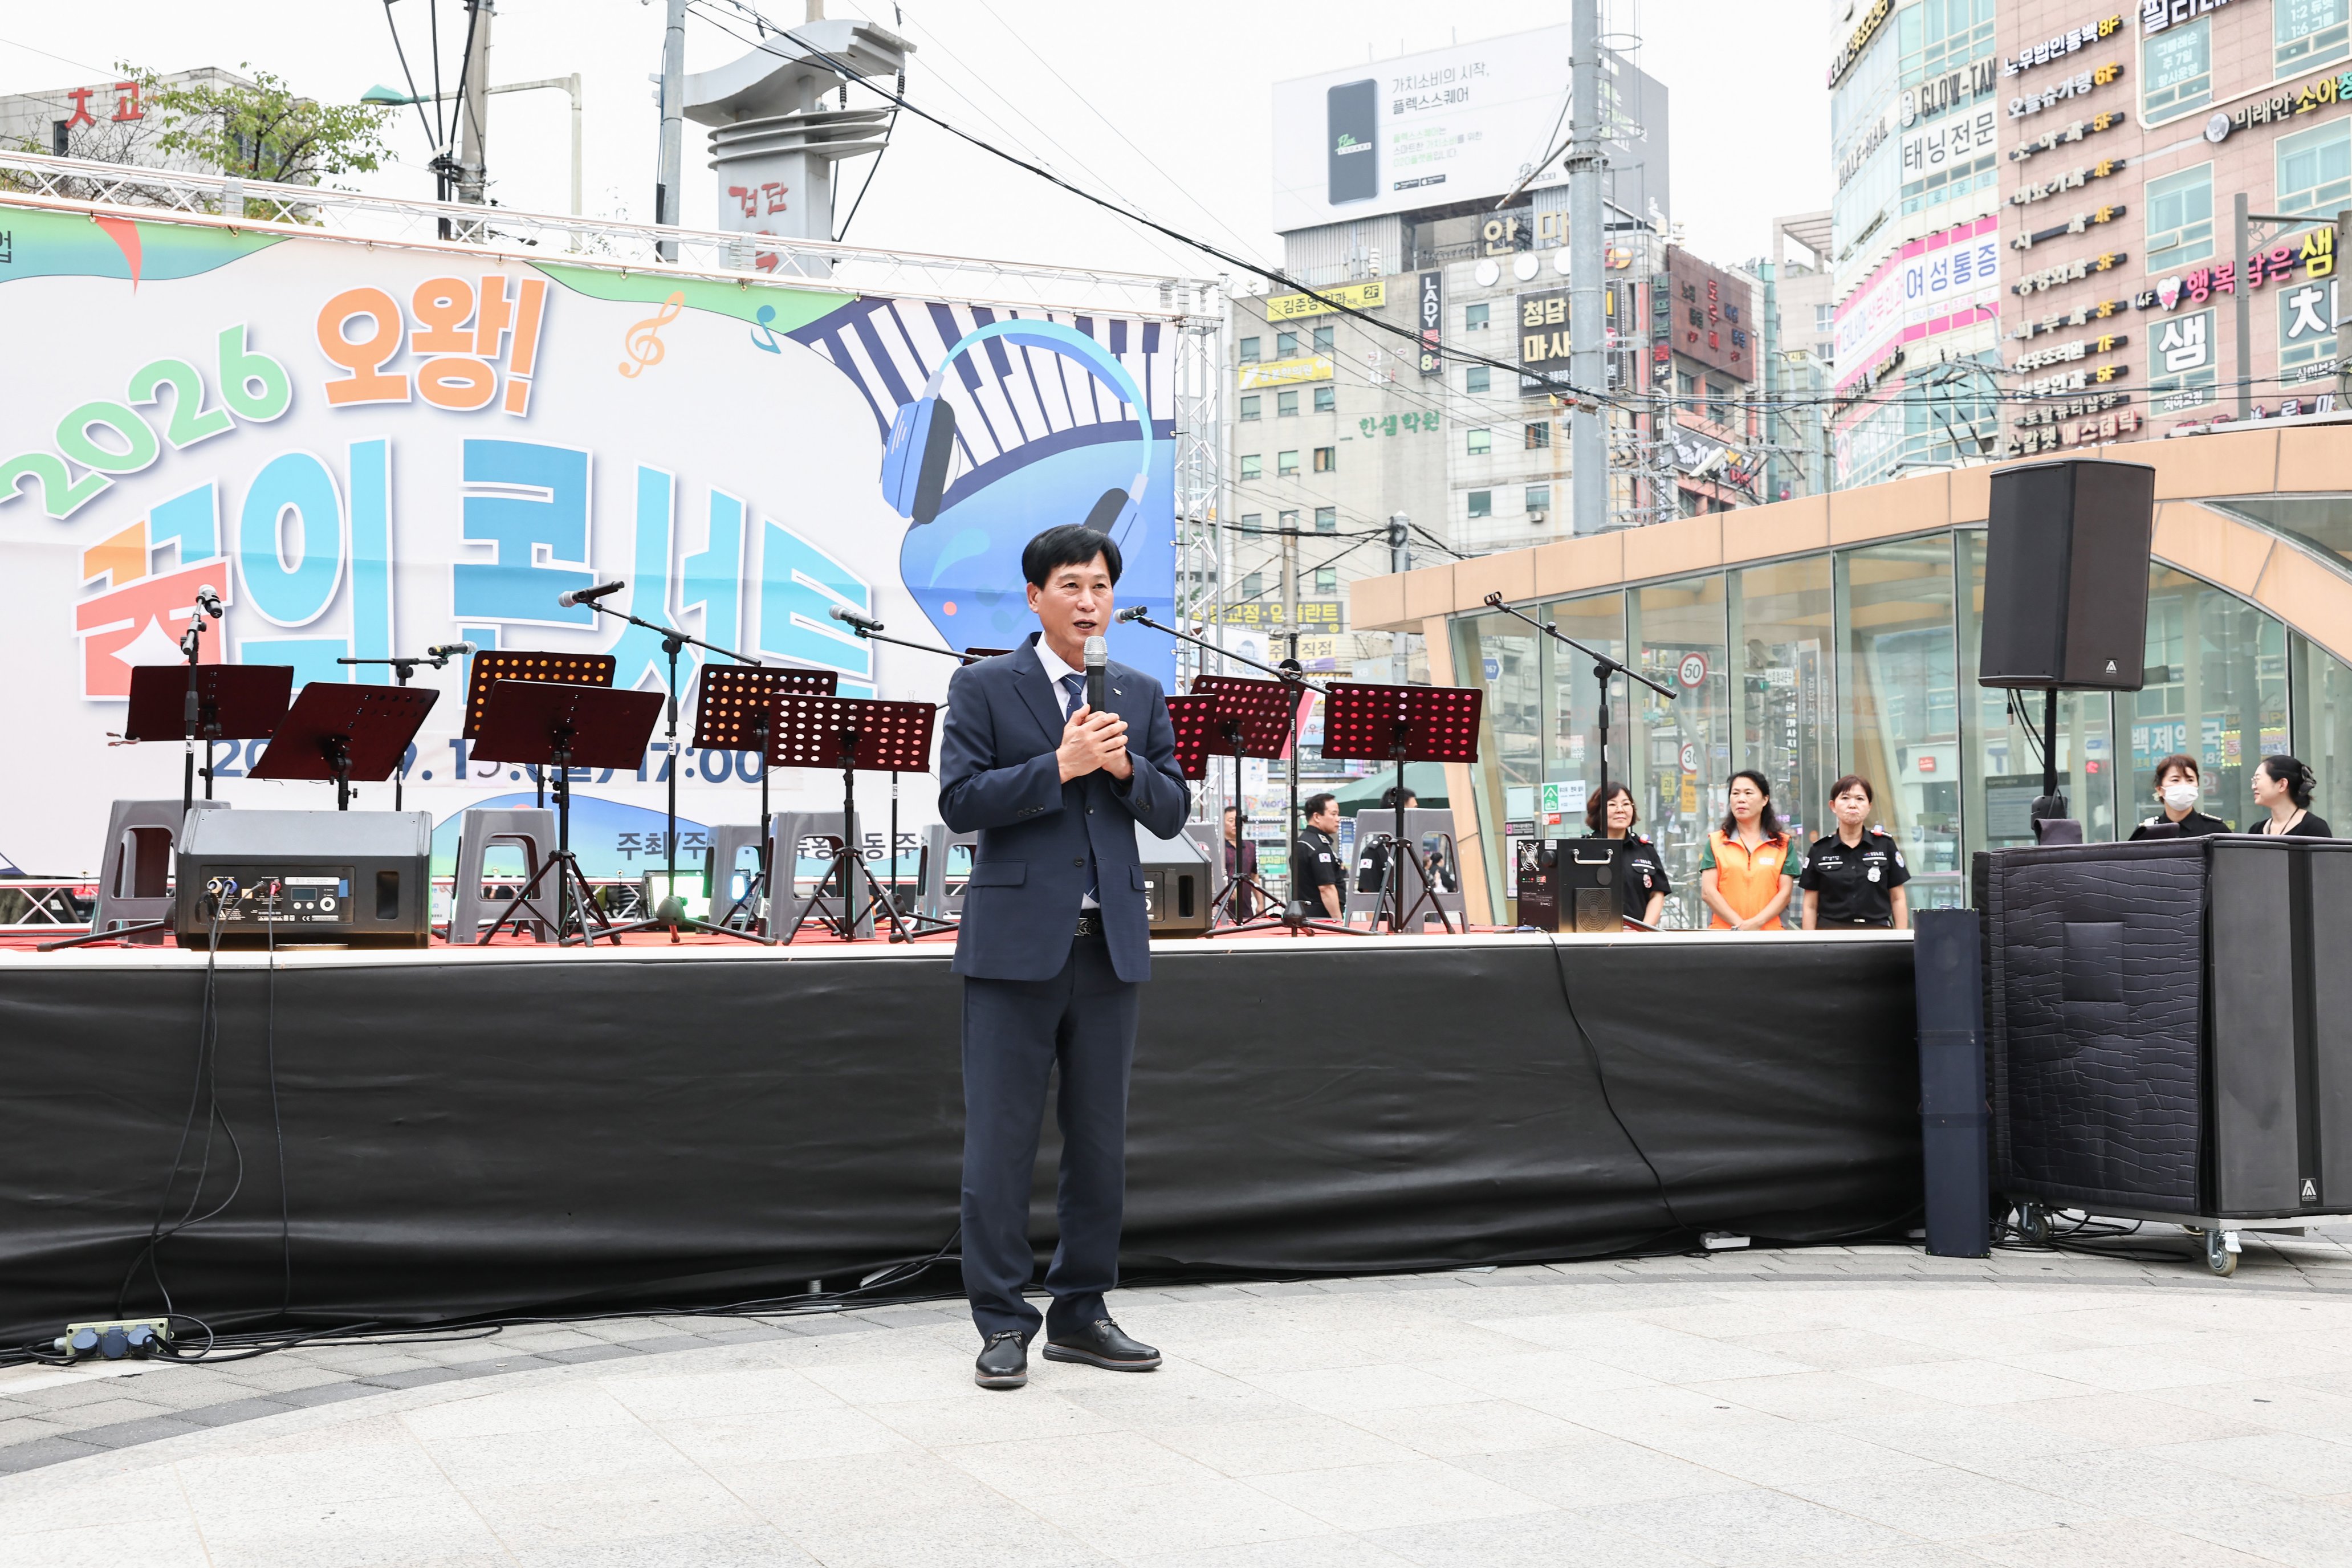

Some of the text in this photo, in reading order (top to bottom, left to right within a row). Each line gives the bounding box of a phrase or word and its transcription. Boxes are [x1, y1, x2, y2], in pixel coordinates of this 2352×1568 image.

[2004, 14, 2121, 78] 노무법인동백 8F
[2291, 22, 2309, 38] 1:6
[1392, 62, 1490, 93] 가치소비의 시작,
[1921, 58, 1997, 118] GLOW-TAN
[2008, 62, 2118, 119] 오늘슈가링 6F
[2157, 62, 2199, 88] 항시운영
[1393, 86, 1469, 115] 플렉스스퀘어
[2235, 92, 2293, 129] 미래안
[1838, 117, 1888, 189] HALF-NAIL
[1904, 111, 1995, 170] 태닝전문
[2013, 111, 2113, 162] 소아과 5F
[2094, 158, 2114, 178] 4F
[728, 181, 789, 218] 검단
[2094, 204, 2114, 223] 4F
[1906, 242, 1997, 299] 여성통증
[2097, 251, 2115, 271] 3F
[1365, 286, 1378, 298] 2F
[1423, 276, 1439, 328] LADY
[2137, 292, 2153, 307] 4F
[1523, 297, 1567, 328] 청담
[2016, 299, 2115, 339] 피부과 3F
[314, 273, 550, 418] 오왕!
[1523, 331, 1572, 363] 마사
[2015, 333, 2115, 372] 산후조리원 7F
[2158, 312, 2207, 373] 샘
[1420, 353, 1441, 372] 8F
[1654, 364, 1669, 377] 5F
[2016, 364, 2115, 404] 산부인과 5F
[0, 320, 292, 520] 2026
[2008, 408, 2139, 455] 스칼렛 에스테틱
[449, 434, 879, 710] 콘서트
[1301, 640, 1332, 657] 직접
[1357, 667, 1369, 677] KB
[1684, 663, 1701, 679] 50
[616, 830, 717, 861] 주최/주
